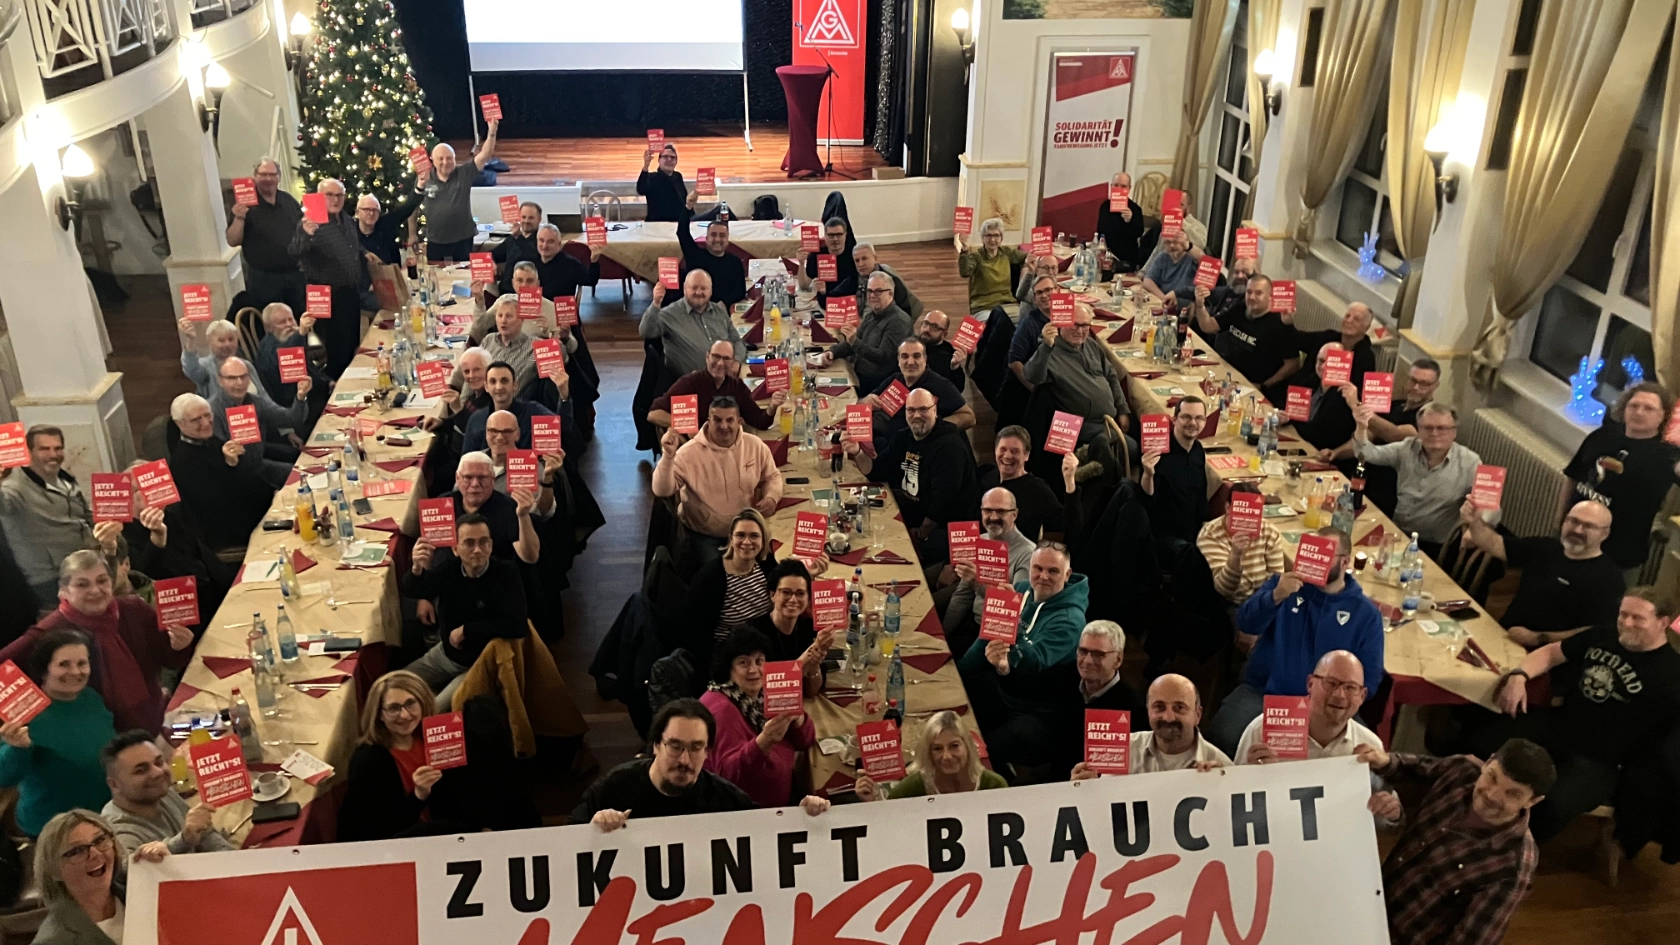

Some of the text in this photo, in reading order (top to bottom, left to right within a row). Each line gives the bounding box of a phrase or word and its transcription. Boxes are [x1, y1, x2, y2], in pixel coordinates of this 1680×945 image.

[1055, 119, 1112, 131] SOLIDARITÄT
[158, 588, 178, 598] JETZT
[765, 673, 784, 681] JETZT
[765, 680, 798, 689] REICHT'S!
[1267, 708, 1289, 717] JETZT
[1088, 722, 1110, 731] JETZT
[1267, 718, 1305, 726] REICHT'S!
[427, 726, 446, 737] JETZT
[1088, 732, 1127, 741] REICHT'S!
[427, 731, 462, 743] REICHT'S!
[861, 733, 880, 744] JETZT
[196, 753, 220, 768] JETZT
[199, 757, 241, 776] REICHT'S!
[446, 786, 1324, 919] ZUKUNFT BRAUCHT
